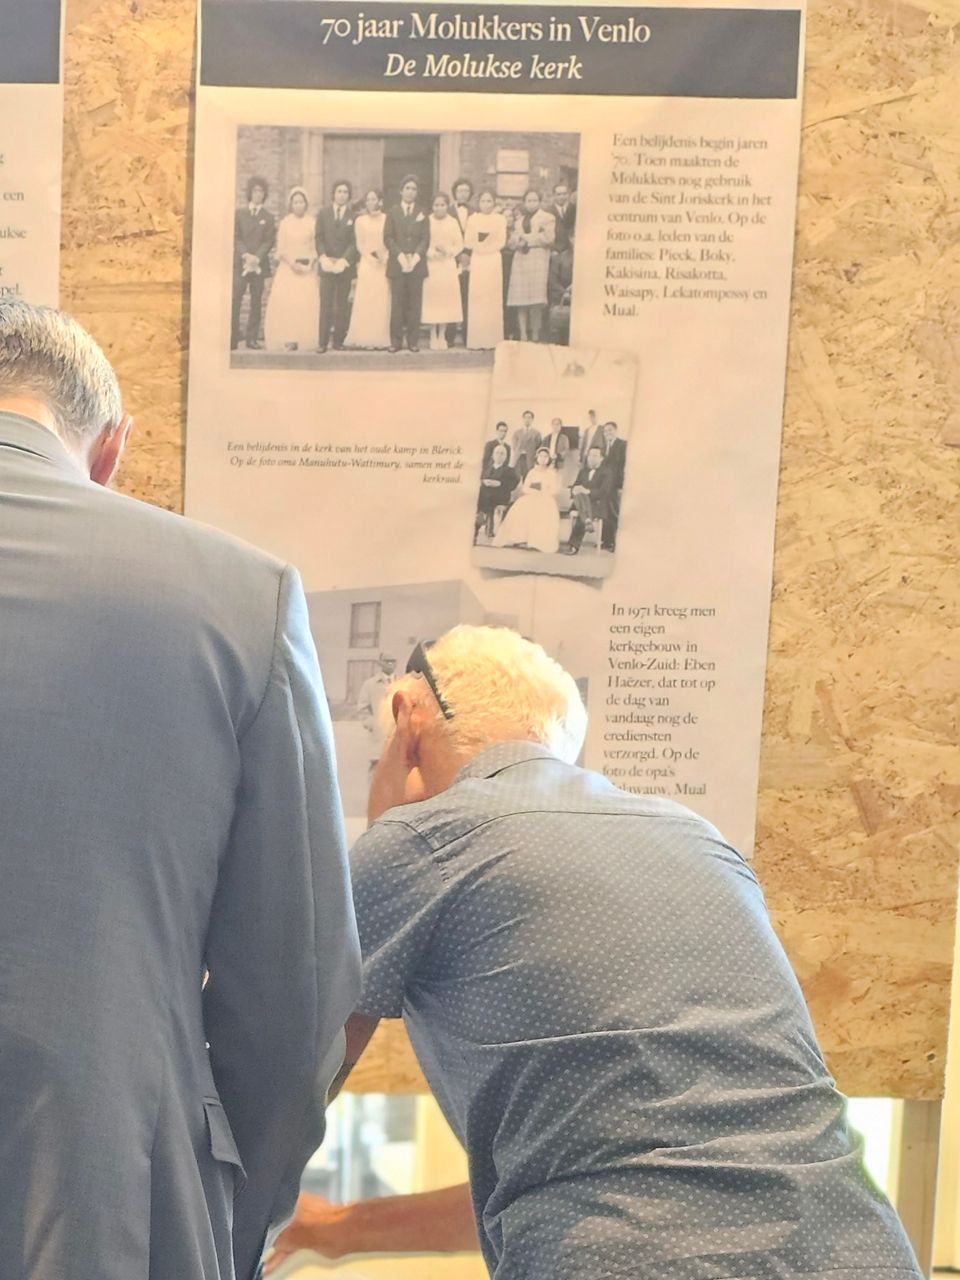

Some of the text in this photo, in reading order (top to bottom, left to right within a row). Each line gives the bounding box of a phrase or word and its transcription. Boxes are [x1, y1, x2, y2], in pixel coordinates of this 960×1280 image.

[319, 12, 651, 45] 70 jaar Molukkers in Venlo
[384, 54, 583, 80] De Molukse kerk
[613, 134, 767, 152] Een belijdenis begin jaren
[635, 153, 666, 167] Toen
[670, 154, 721, 168] maakten
[724, 155, 739, 168] de
[610, 171, 752, 188] Molukkers nog gebruik
[3, 191, 24, 201] een
[609, 191, 771, 205] van de Sint Joriskerk in het
[608, 211, 657, 223] centrum
[661, 213, 681, 223] van
[728, 212, 748, 227] Op
[751, 212, 767, 224] de
[607, 229, 630, 241] foto
[658, 229, 690, 242] leden
[695, 232, 715, 242] van
[719, 231, 733, 242] de
[753, 290, 767, 298] en
[603, 303, 639, 316] Mual.
[612, 604, 715, 620] In 1971 kreeg men
[610, 624, 665, 637] een eigen
[609, 640, 698, 654] kerkgebouw in
[608, 658, 715, 671] Venlo-Zuid: Eben
[658, 677, 677, 688] dat
[681, 679, 696, 688] tot
[700, 680, 715, 691] op
[606, 694, 669, 708] de dag van
[605, 712, 698, 726] vandaag nog de
[663, 748, 682, 762] Op
[685, 748, 699, 760] de
[603, 765, 626, 776] foto
[629, 765, 642, 777] de
[674, 783, 706, 795] Mual
